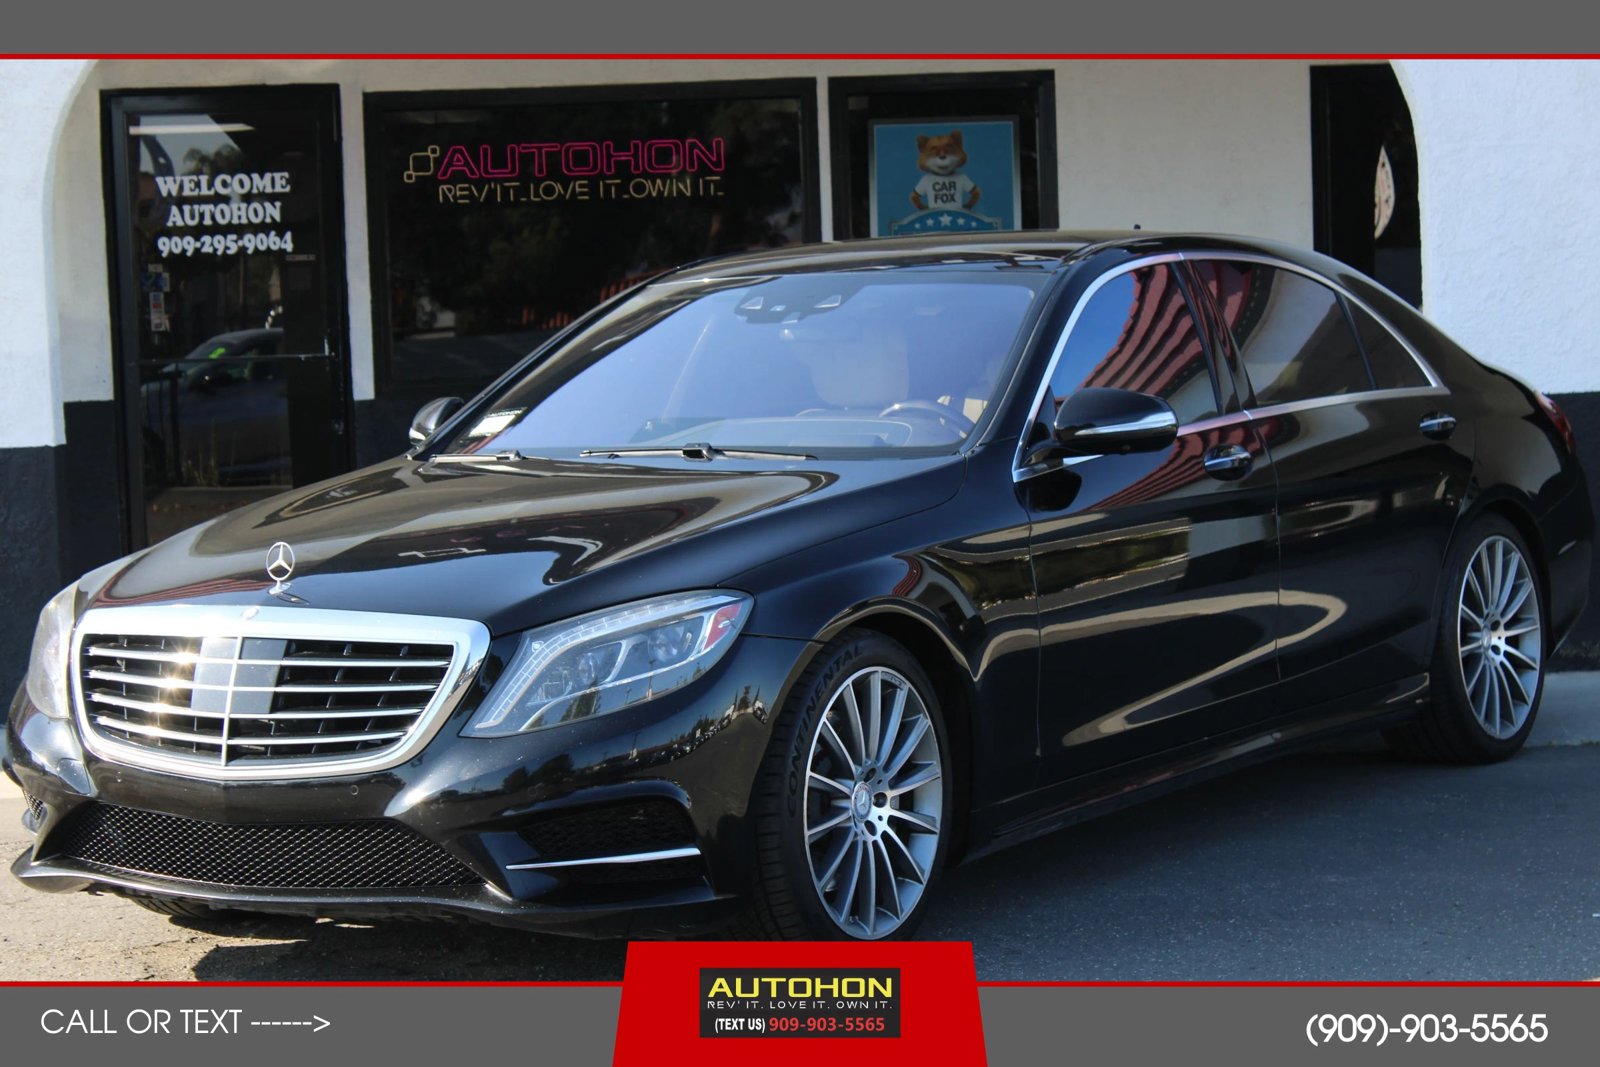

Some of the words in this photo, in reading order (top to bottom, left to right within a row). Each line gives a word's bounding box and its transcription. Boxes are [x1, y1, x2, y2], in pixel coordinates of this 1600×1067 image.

[437, 138, 725, 179] AUTOHON
[155, 172, 290, 197] WELCOME
[530, 180, 590, 201] LOVE
[629, 177, 691, 198] OWN
[932, 181, 957, 192] CAR
[933, 193, 957, 204] FOX
[166, 202, 282, 226] AUTOHON
[157, 230, 294, 257] 909-295-9064
[787, 645, 864, 818] CONTINENTAL
